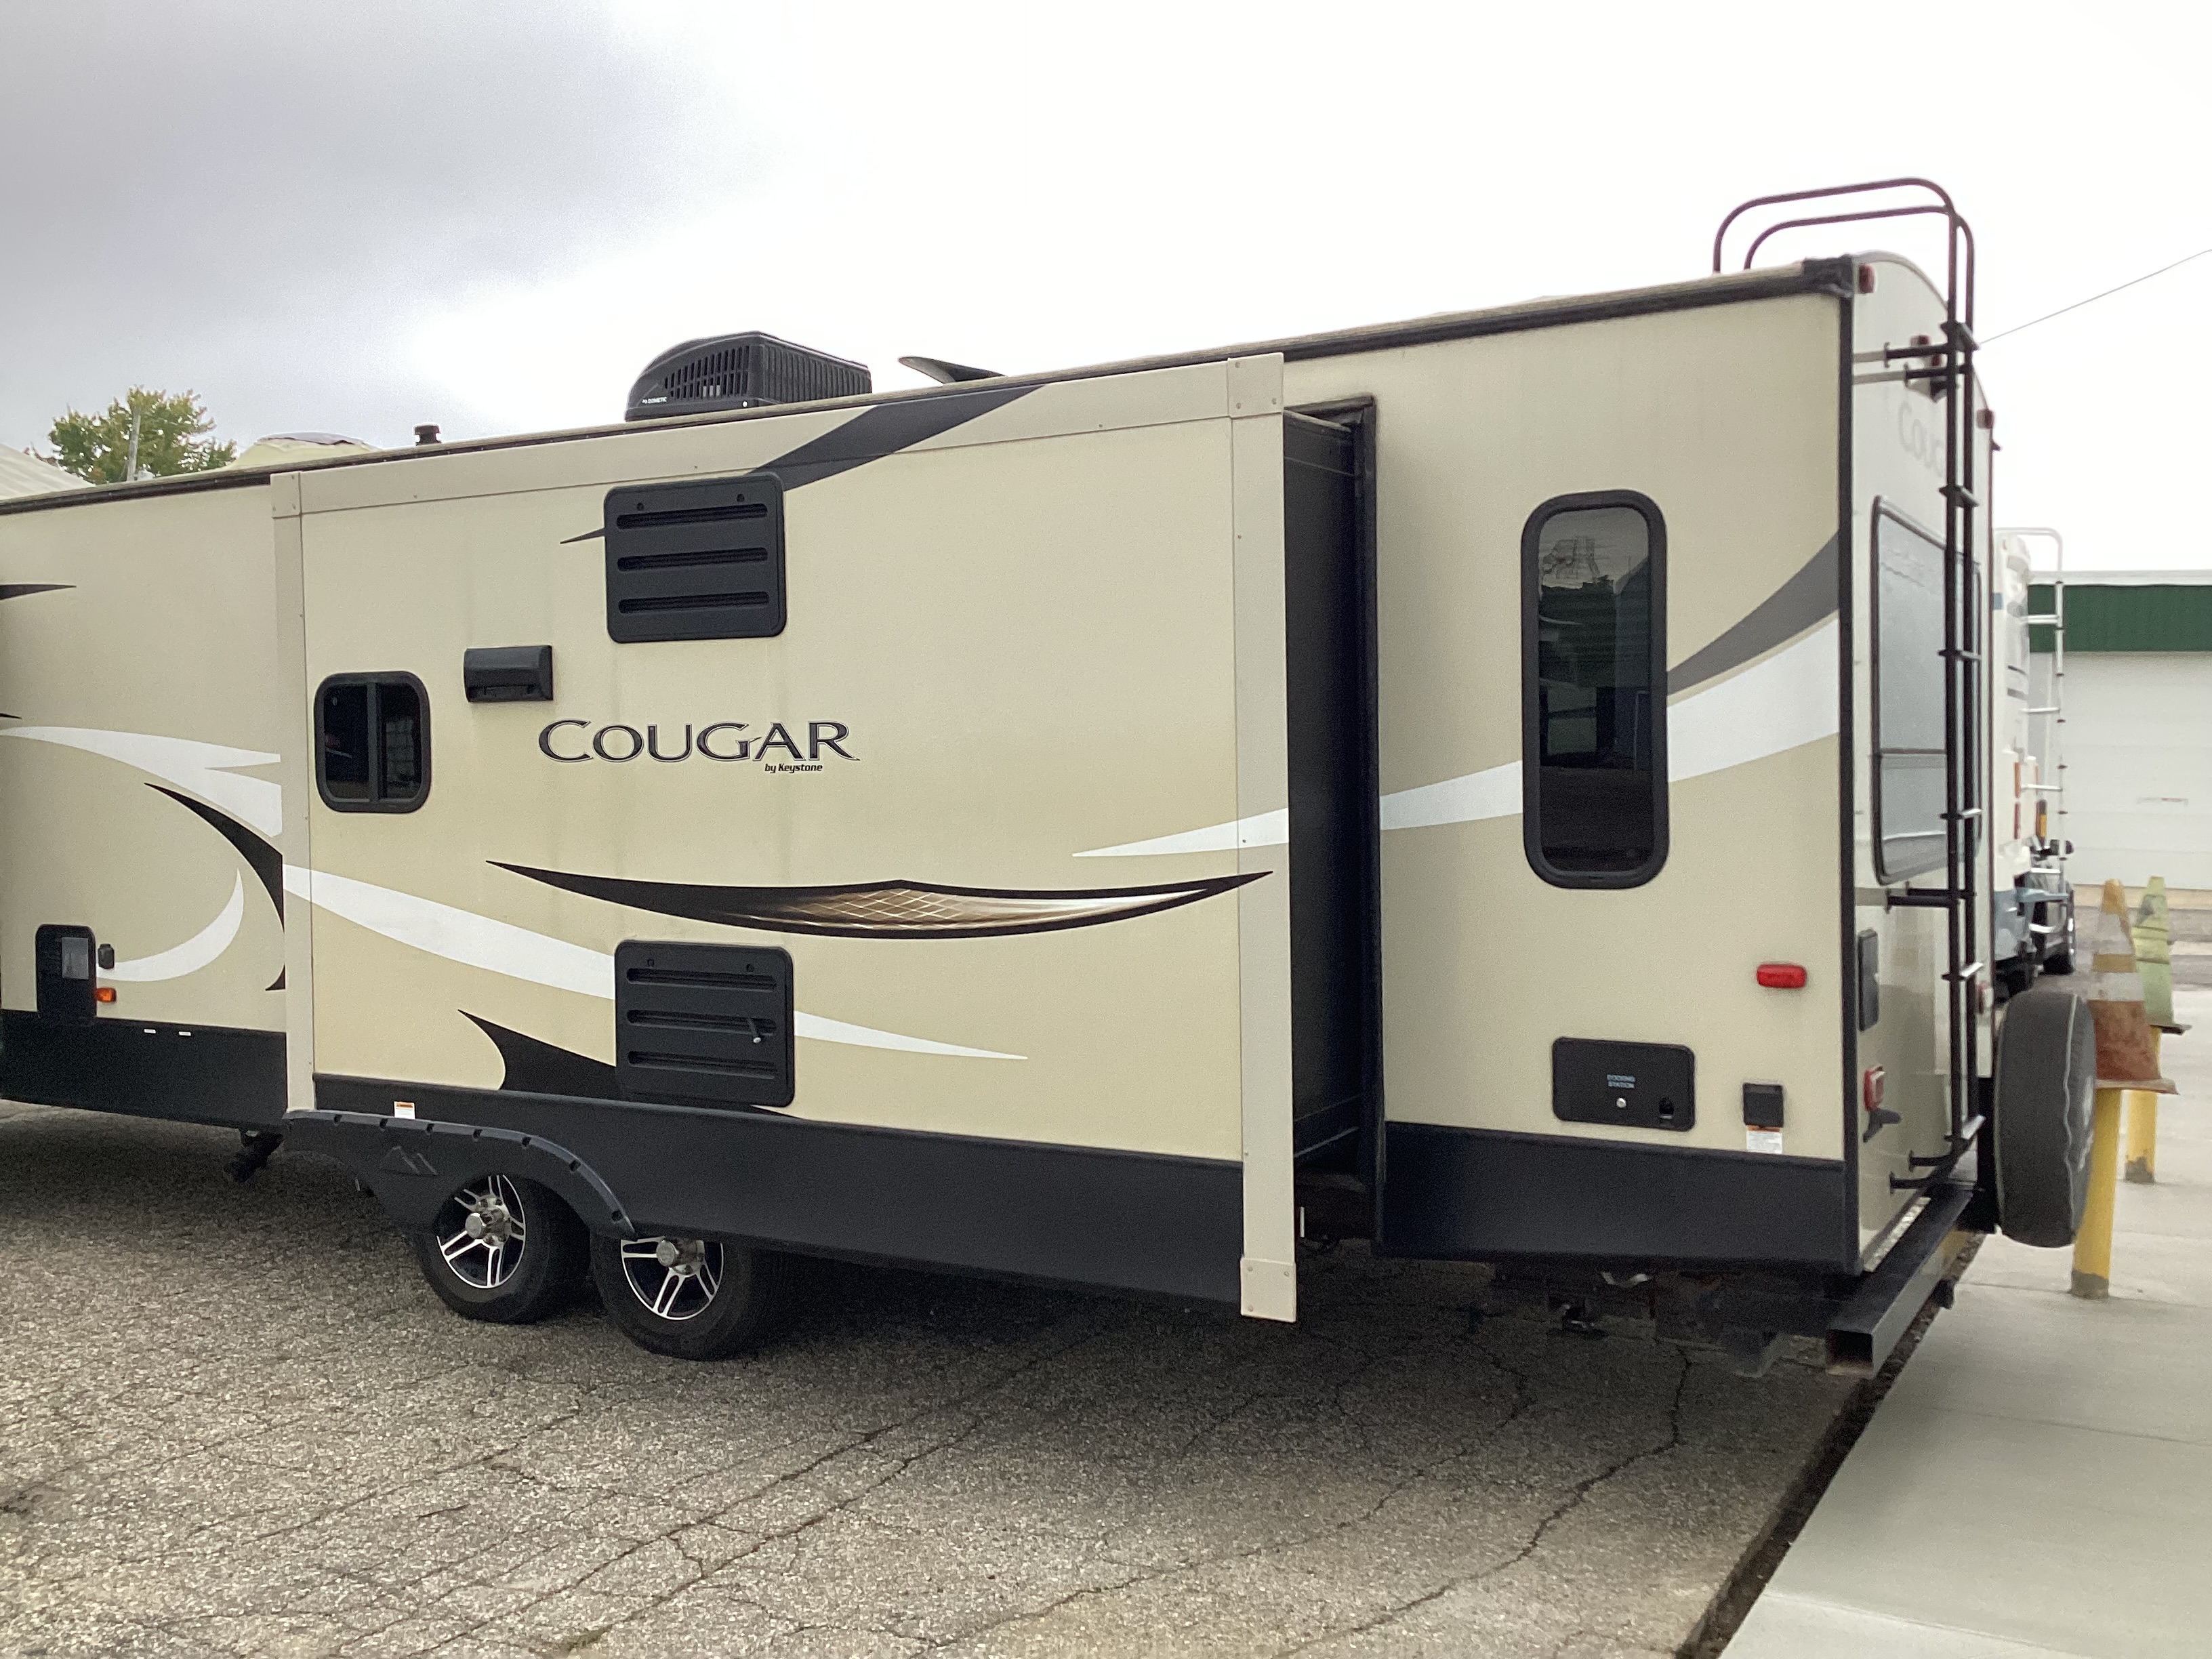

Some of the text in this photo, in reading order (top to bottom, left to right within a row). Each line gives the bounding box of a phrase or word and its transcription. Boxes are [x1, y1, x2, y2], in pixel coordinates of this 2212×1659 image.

[538, 718, 861, 763] COUGAR
[764, 763, 823, 774] by Keystone
